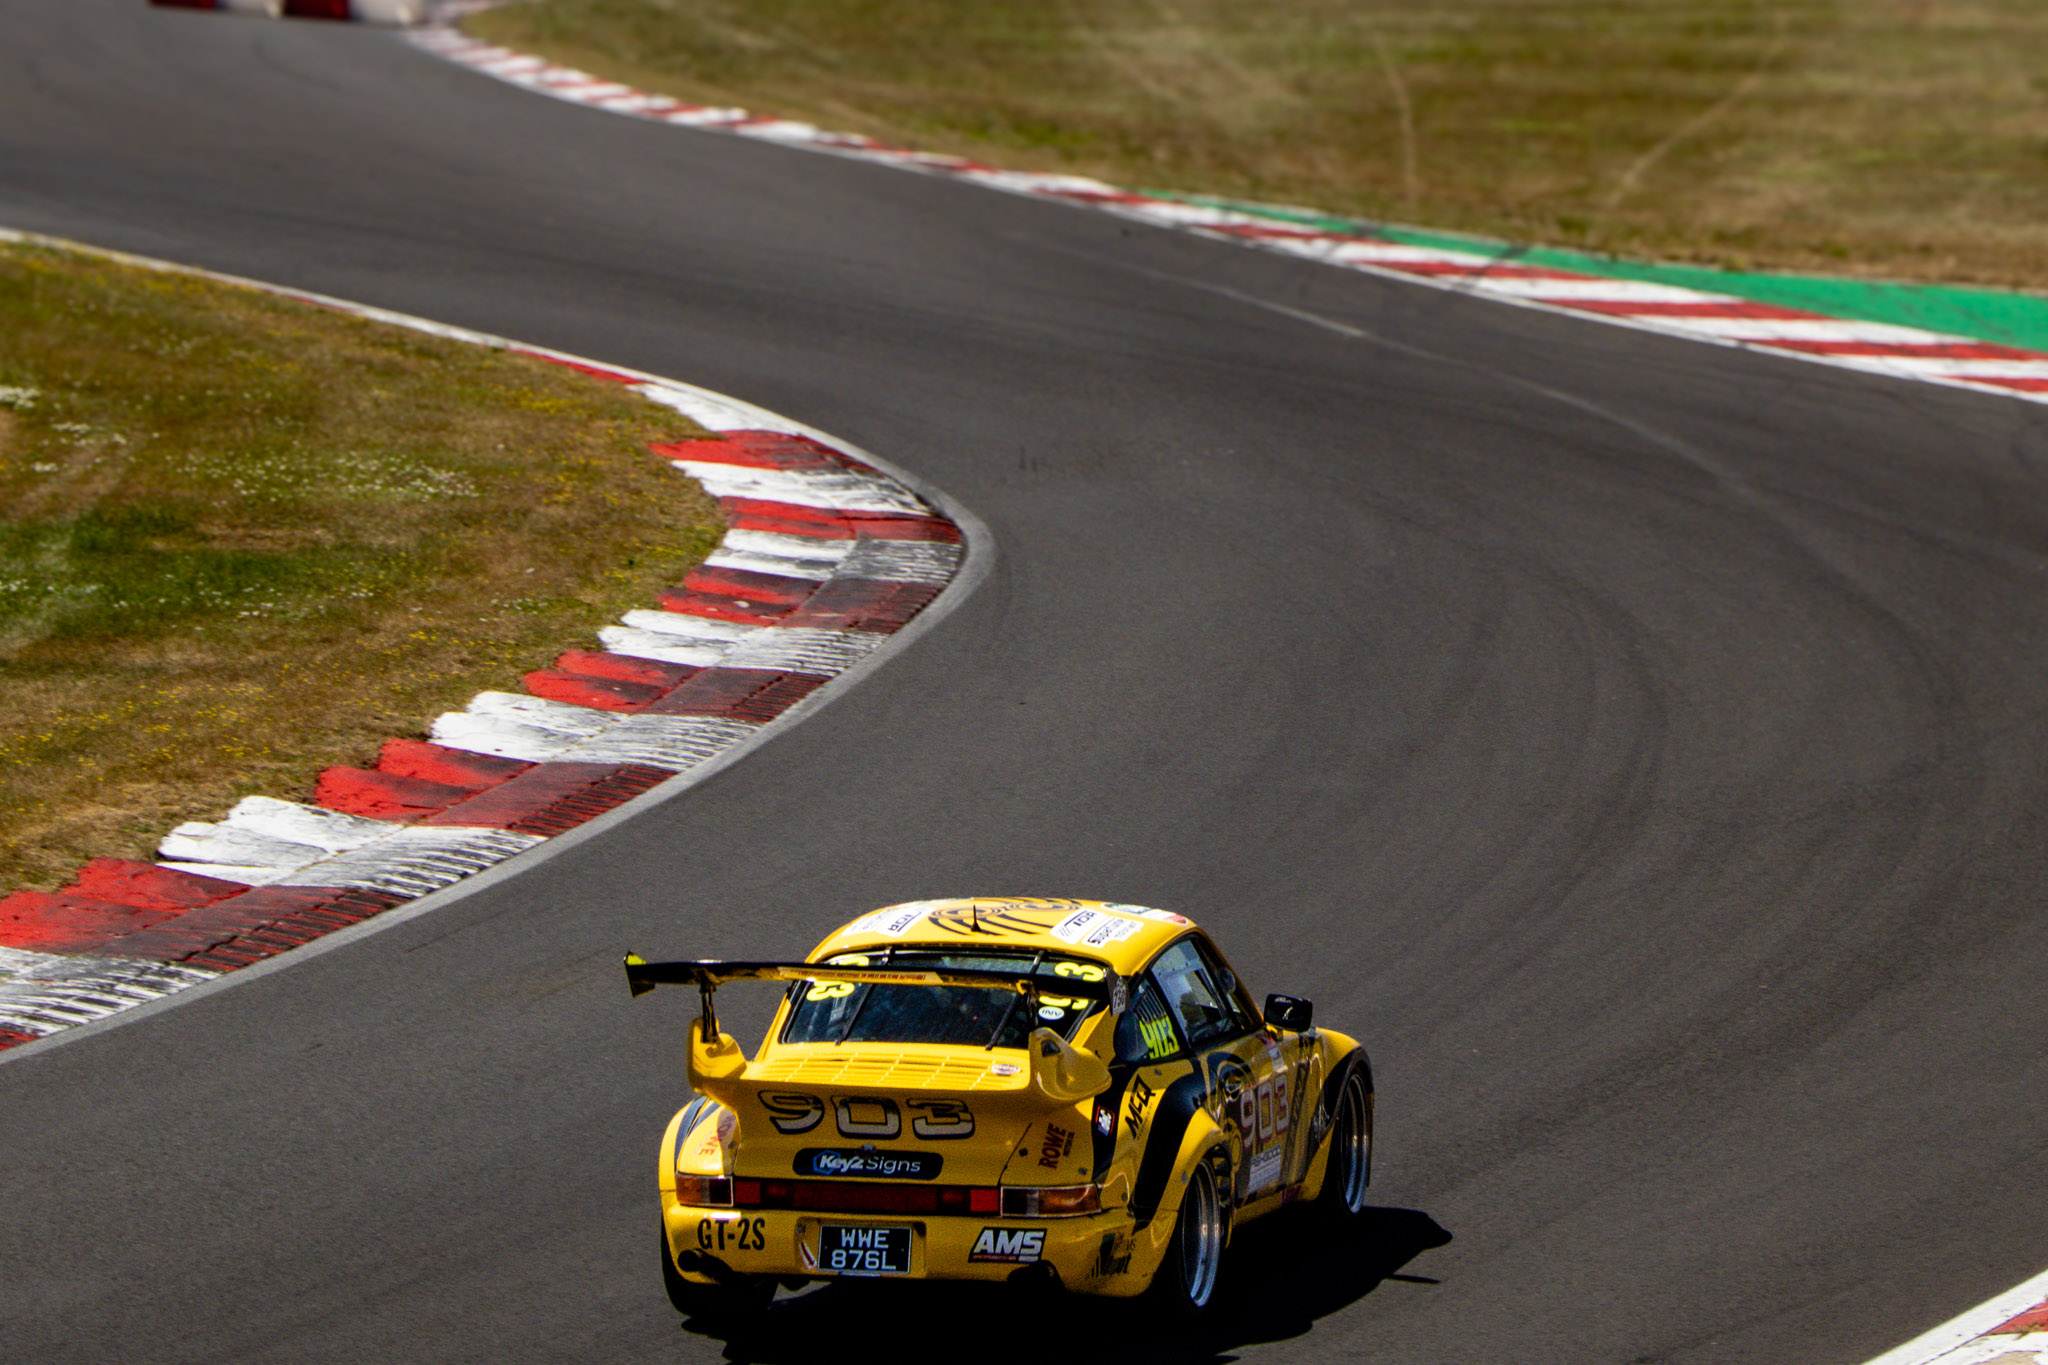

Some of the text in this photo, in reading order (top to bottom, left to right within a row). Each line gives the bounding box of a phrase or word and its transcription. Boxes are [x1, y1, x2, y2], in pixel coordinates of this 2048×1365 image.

[1139, 1015, 1180, 1060] 903
[758, 1089, 975, 1140] 903
[1240, 1073, 1289, 1149] 903
[1038, 1122, 1067, 1170] ROWE
[819, 1154, 921, 1175] Key2 Signs
[697, 1217, 765, 1251] GT-2S
[841, 1228, 890, 1249] WWE
[973, 1229, 1045, 1256] AMS
[830, 1249, 897, 1271] 876L
